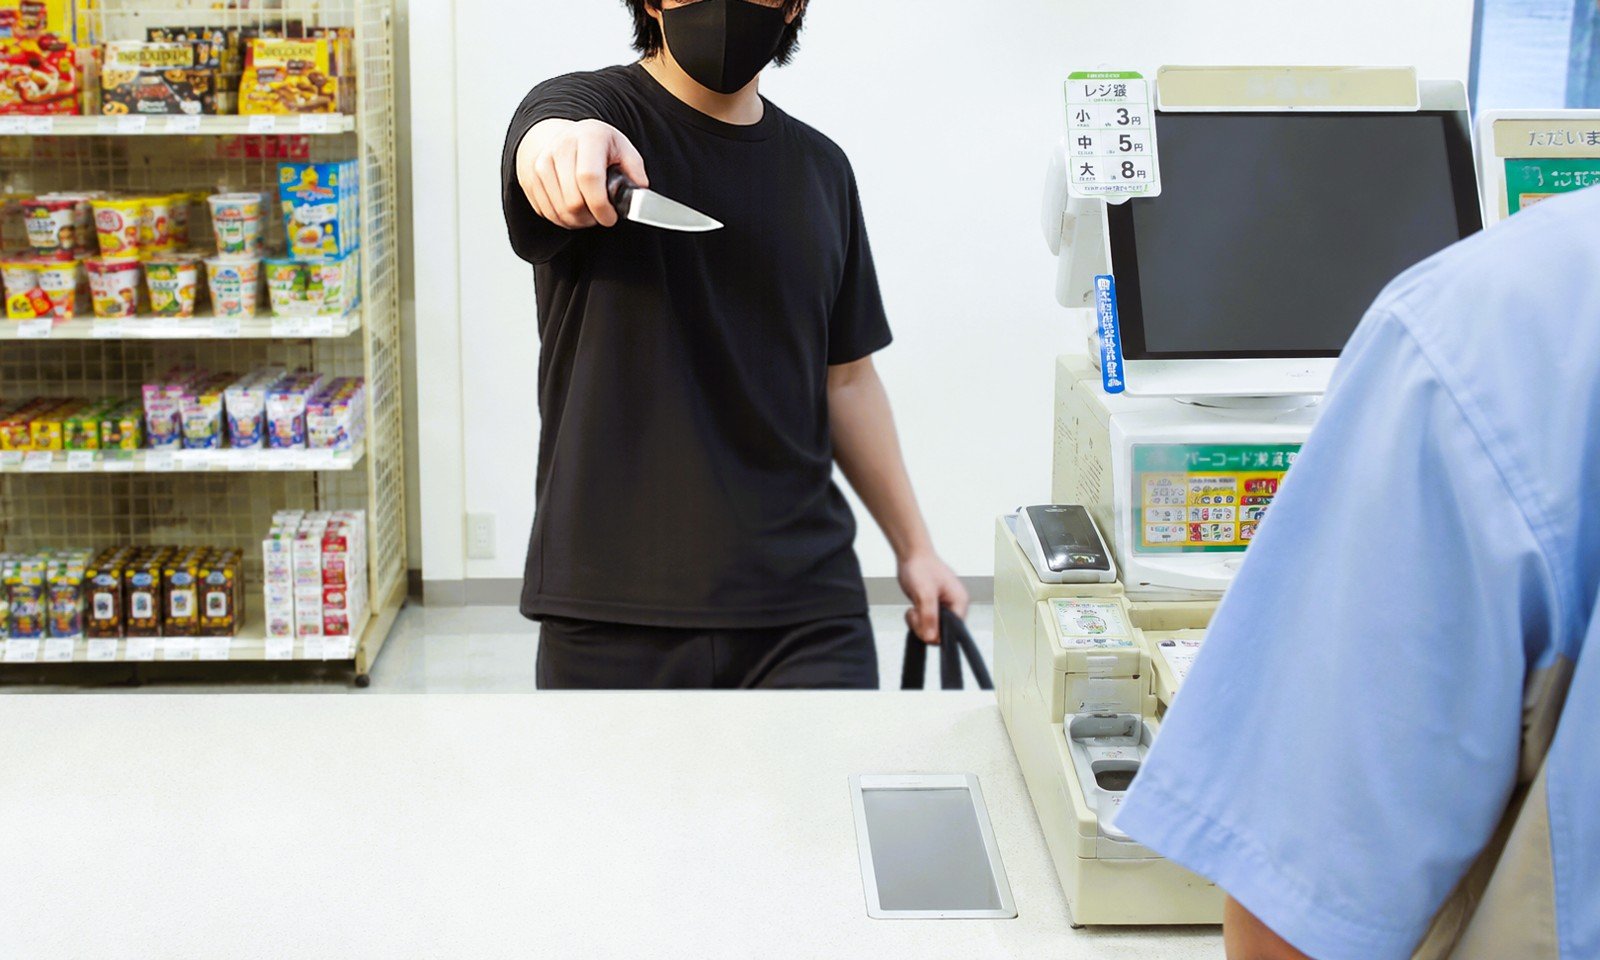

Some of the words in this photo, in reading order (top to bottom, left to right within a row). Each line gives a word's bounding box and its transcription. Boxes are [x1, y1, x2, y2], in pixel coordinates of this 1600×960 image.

[1076, 109, 1091, 122] 小
[1116, 108, 1141, 126] 3円
[1077, 135, 1092, 149] 中
[1119, 134, 1144, 152] 5円
[1528, 129, 1600, 146] ただいま
[1080, 162, 1095, 176] 大
[1121, 161, 1147, 179] 8円
